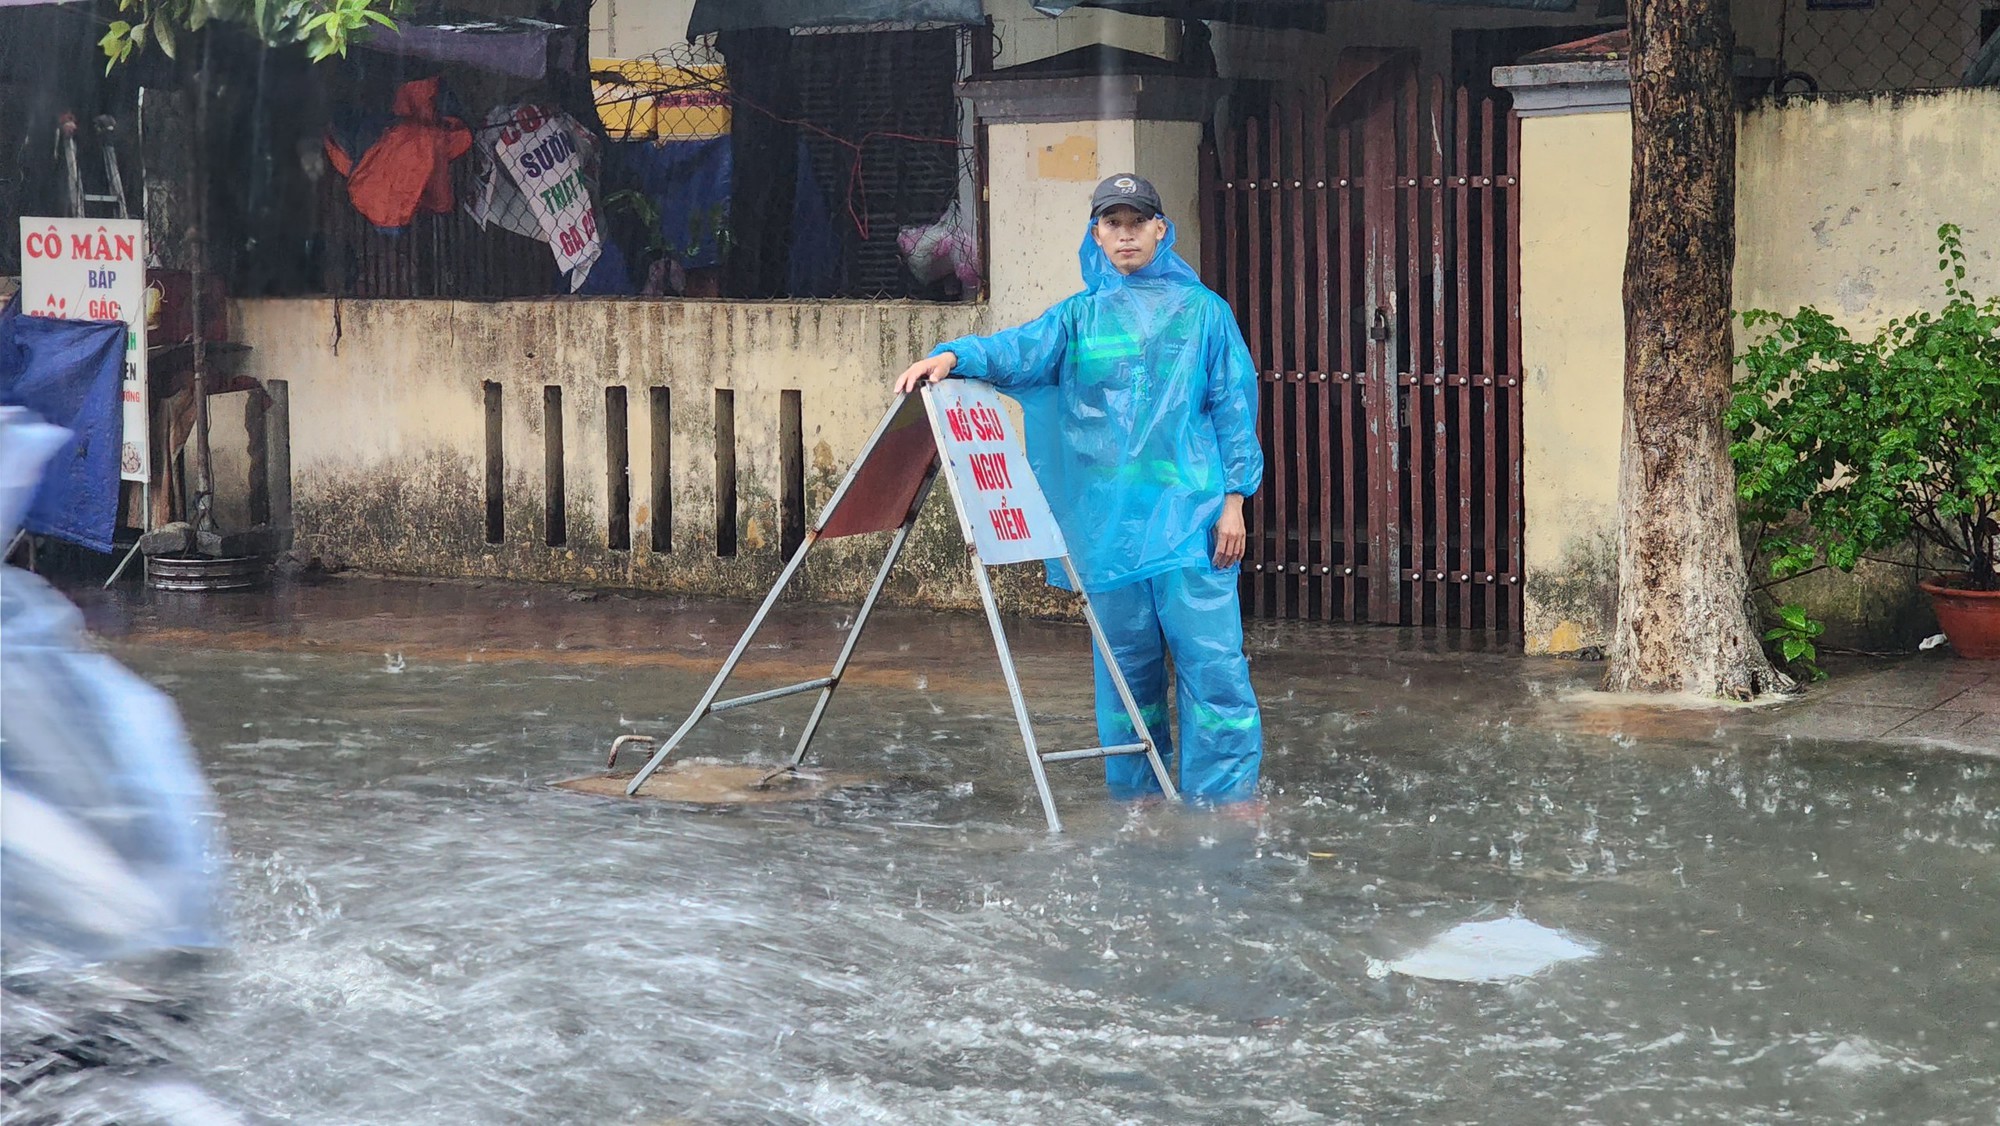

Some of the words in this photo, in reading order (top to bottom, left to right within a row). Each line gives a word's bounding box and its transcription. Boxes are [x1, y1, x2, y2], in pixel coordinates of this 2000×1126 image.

[26, 224, 62, 259] CÔ
[70, 225, 135, 262] MÂN
[88, 264, 117, 289] BẮP
[89, 294, 119, 320] GẤC
[969, 400, 1004, 442] SÂU
[969, 452, 1013, 491] NGUY
[989, 495, 1031, 541] HIỂM
